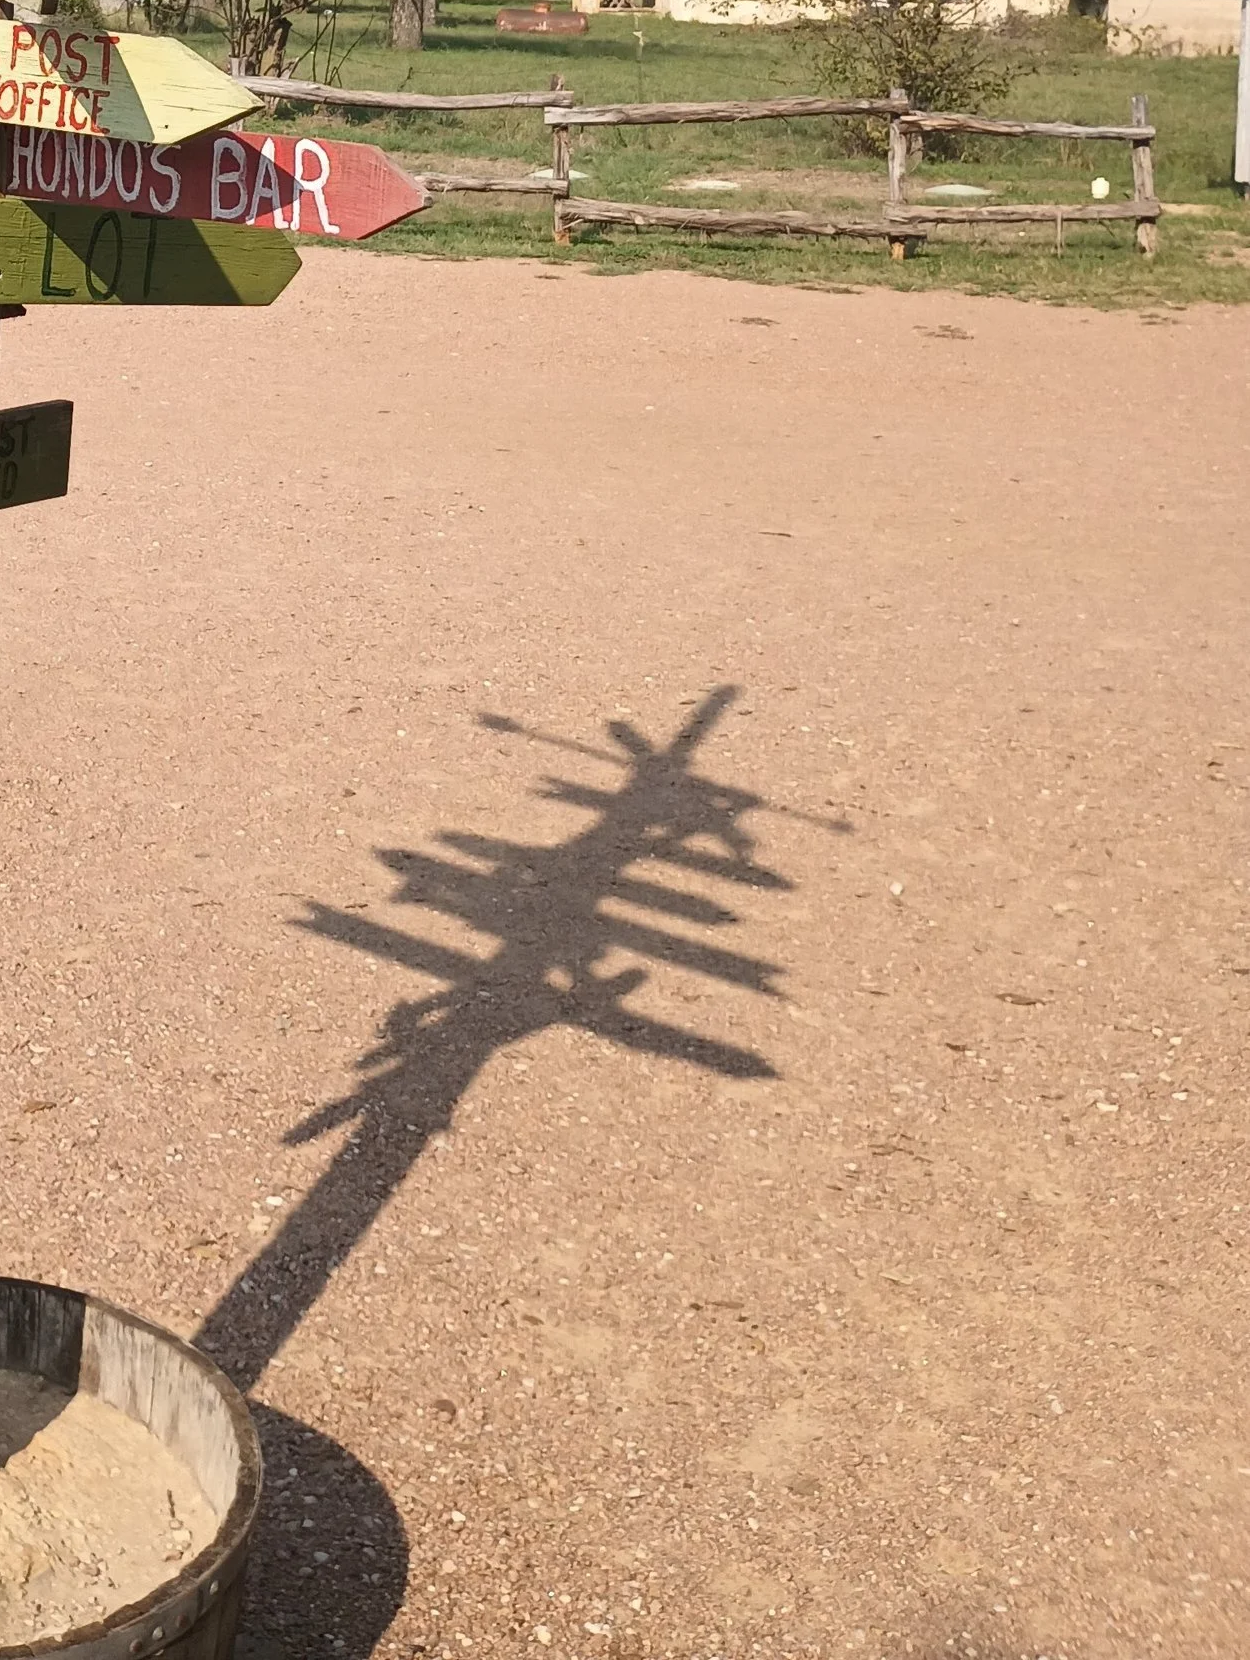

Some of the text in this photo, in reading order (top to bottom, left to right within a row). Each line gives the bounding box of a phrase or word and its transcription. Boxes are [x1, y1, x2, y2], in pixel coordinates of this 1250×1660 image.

[10, 24, 121, 86] POST
[210, 136, 341, 235] BAR
[40, 210, 177, 301] LOT
